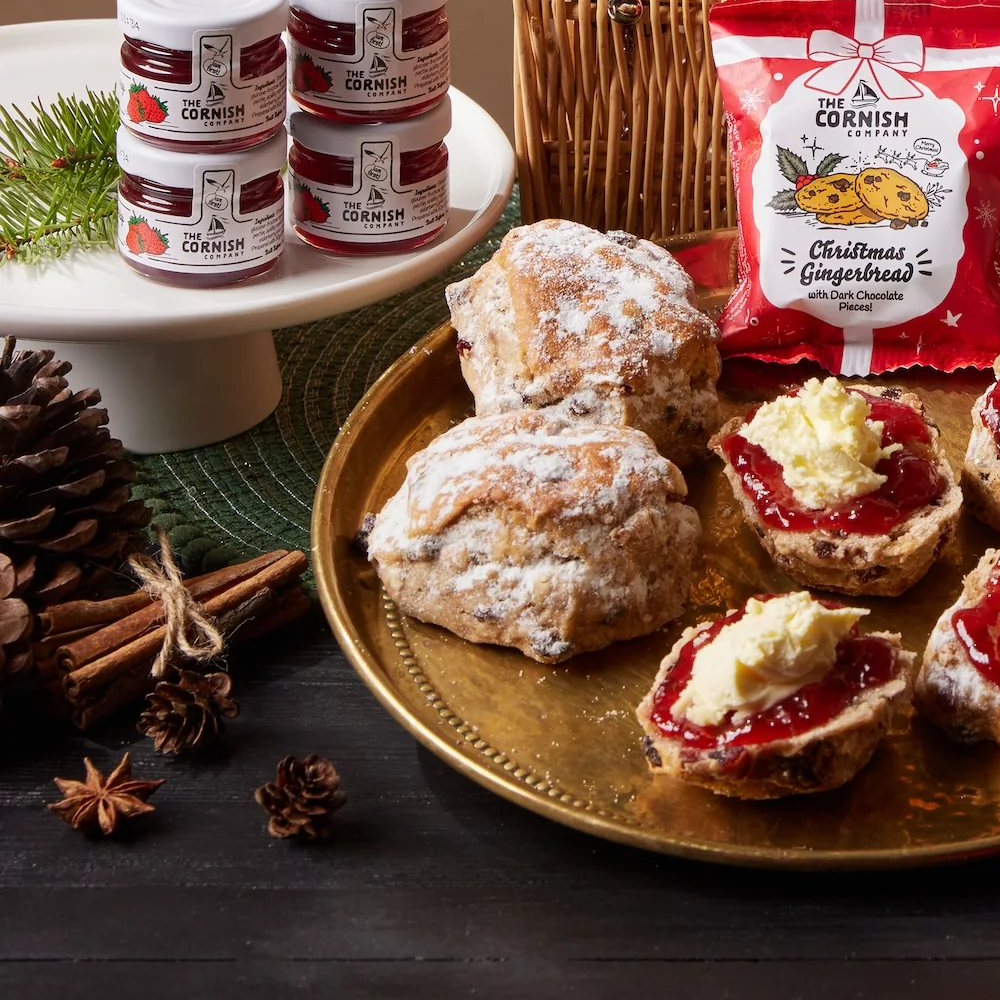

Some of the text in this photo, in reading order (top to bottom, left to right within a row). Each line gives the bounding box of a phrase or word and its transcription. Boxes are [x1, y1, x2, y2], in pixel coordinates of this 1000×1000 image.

[346, 70, 364, 78] THE
[345, 75, 407, 91] CORNISH
[367, 89, 407, 97] COMPANY
[182, 99, 201, 107] THE
[818, 98, 844, 108] THE
[181, 104, 245, 120] CORNISH
[204, 118, 244, 127] COMPANY
[815, 110, 909, 128] CORNISH
[847, 129, 908, 137] COMPANY
[343, 201, 361, 210] THE
[342, 208, 405, 222] CORNISH
[364, 221, 404, 229] COMPANY
[184, 232, 202, 240] THE
[182, 237, 245, 253] CORNISH
[809, 239, 906, 260] Christmas
[204, 251, 244, 260] COMPANY
[800, 262, 914, 287] Gingerbread
[808, 289, 904, 301] with Dark Chocolate
[839, 302, 873, 312] Pieces!
